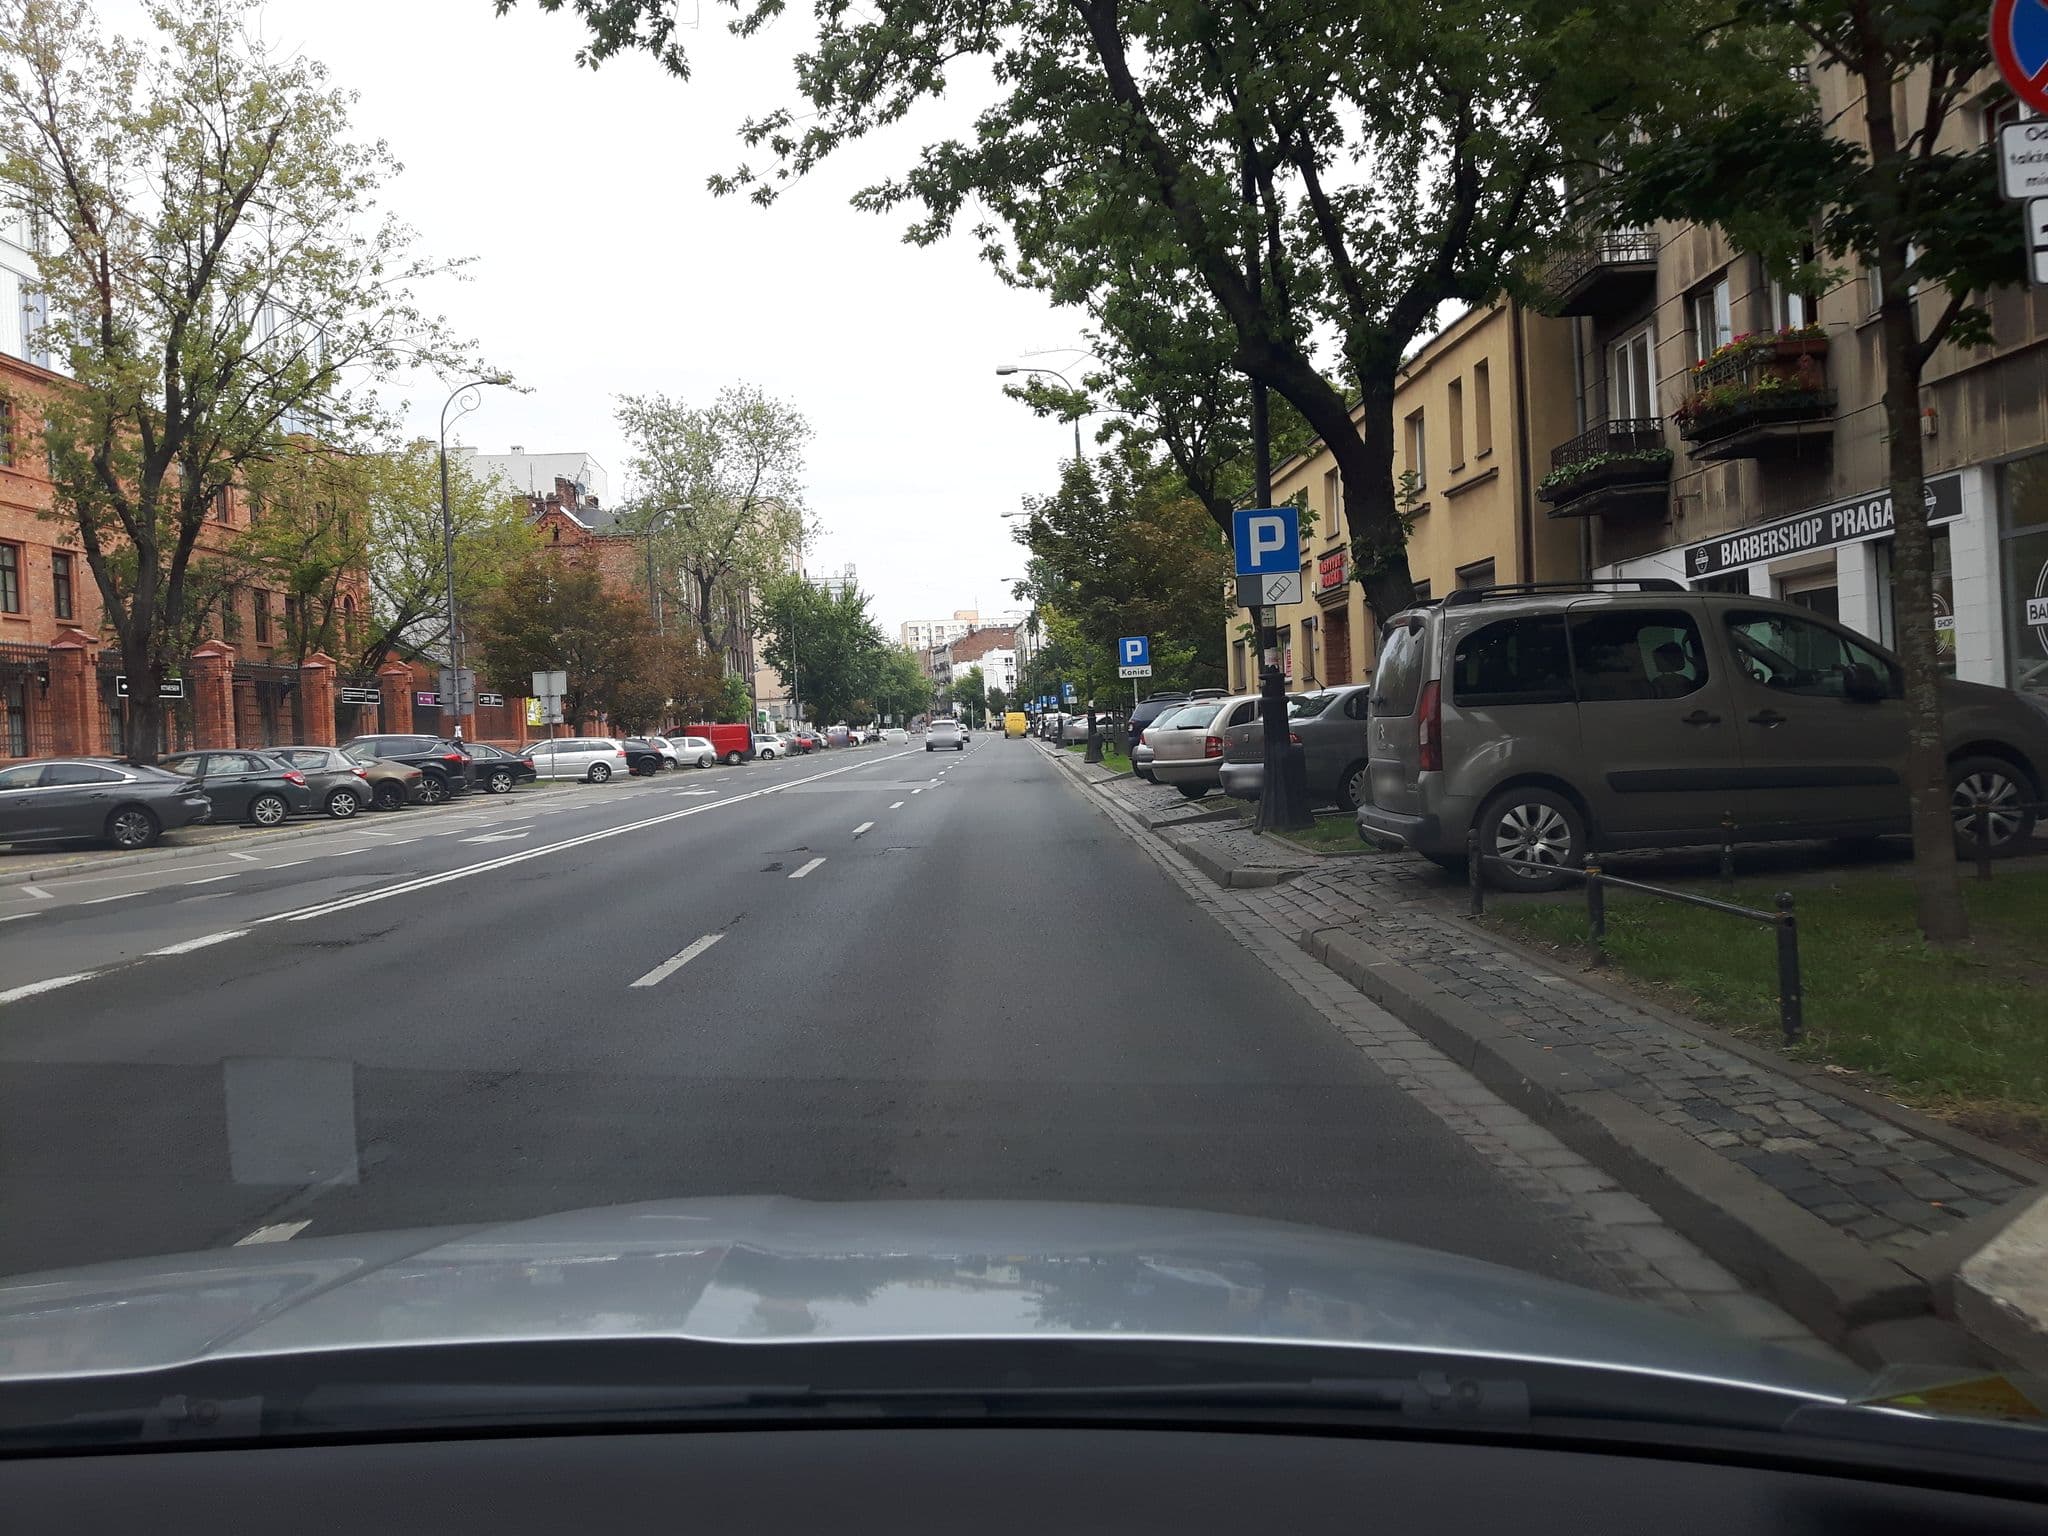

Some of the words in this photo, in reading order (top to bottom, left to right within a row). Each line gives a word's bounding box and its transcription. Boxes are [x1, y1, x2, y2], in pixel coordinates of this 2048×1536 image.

[1249, 516, 1286, 567] P
[1720, 517, 1822, 566] BARBERSHOP
[1831, 498, 1894, 539] PRAGA
[2029, 602, 2048, 621] BA
[1126, 640, 1143, 663] P
[1121, 667, 1150, 676] Koniec
